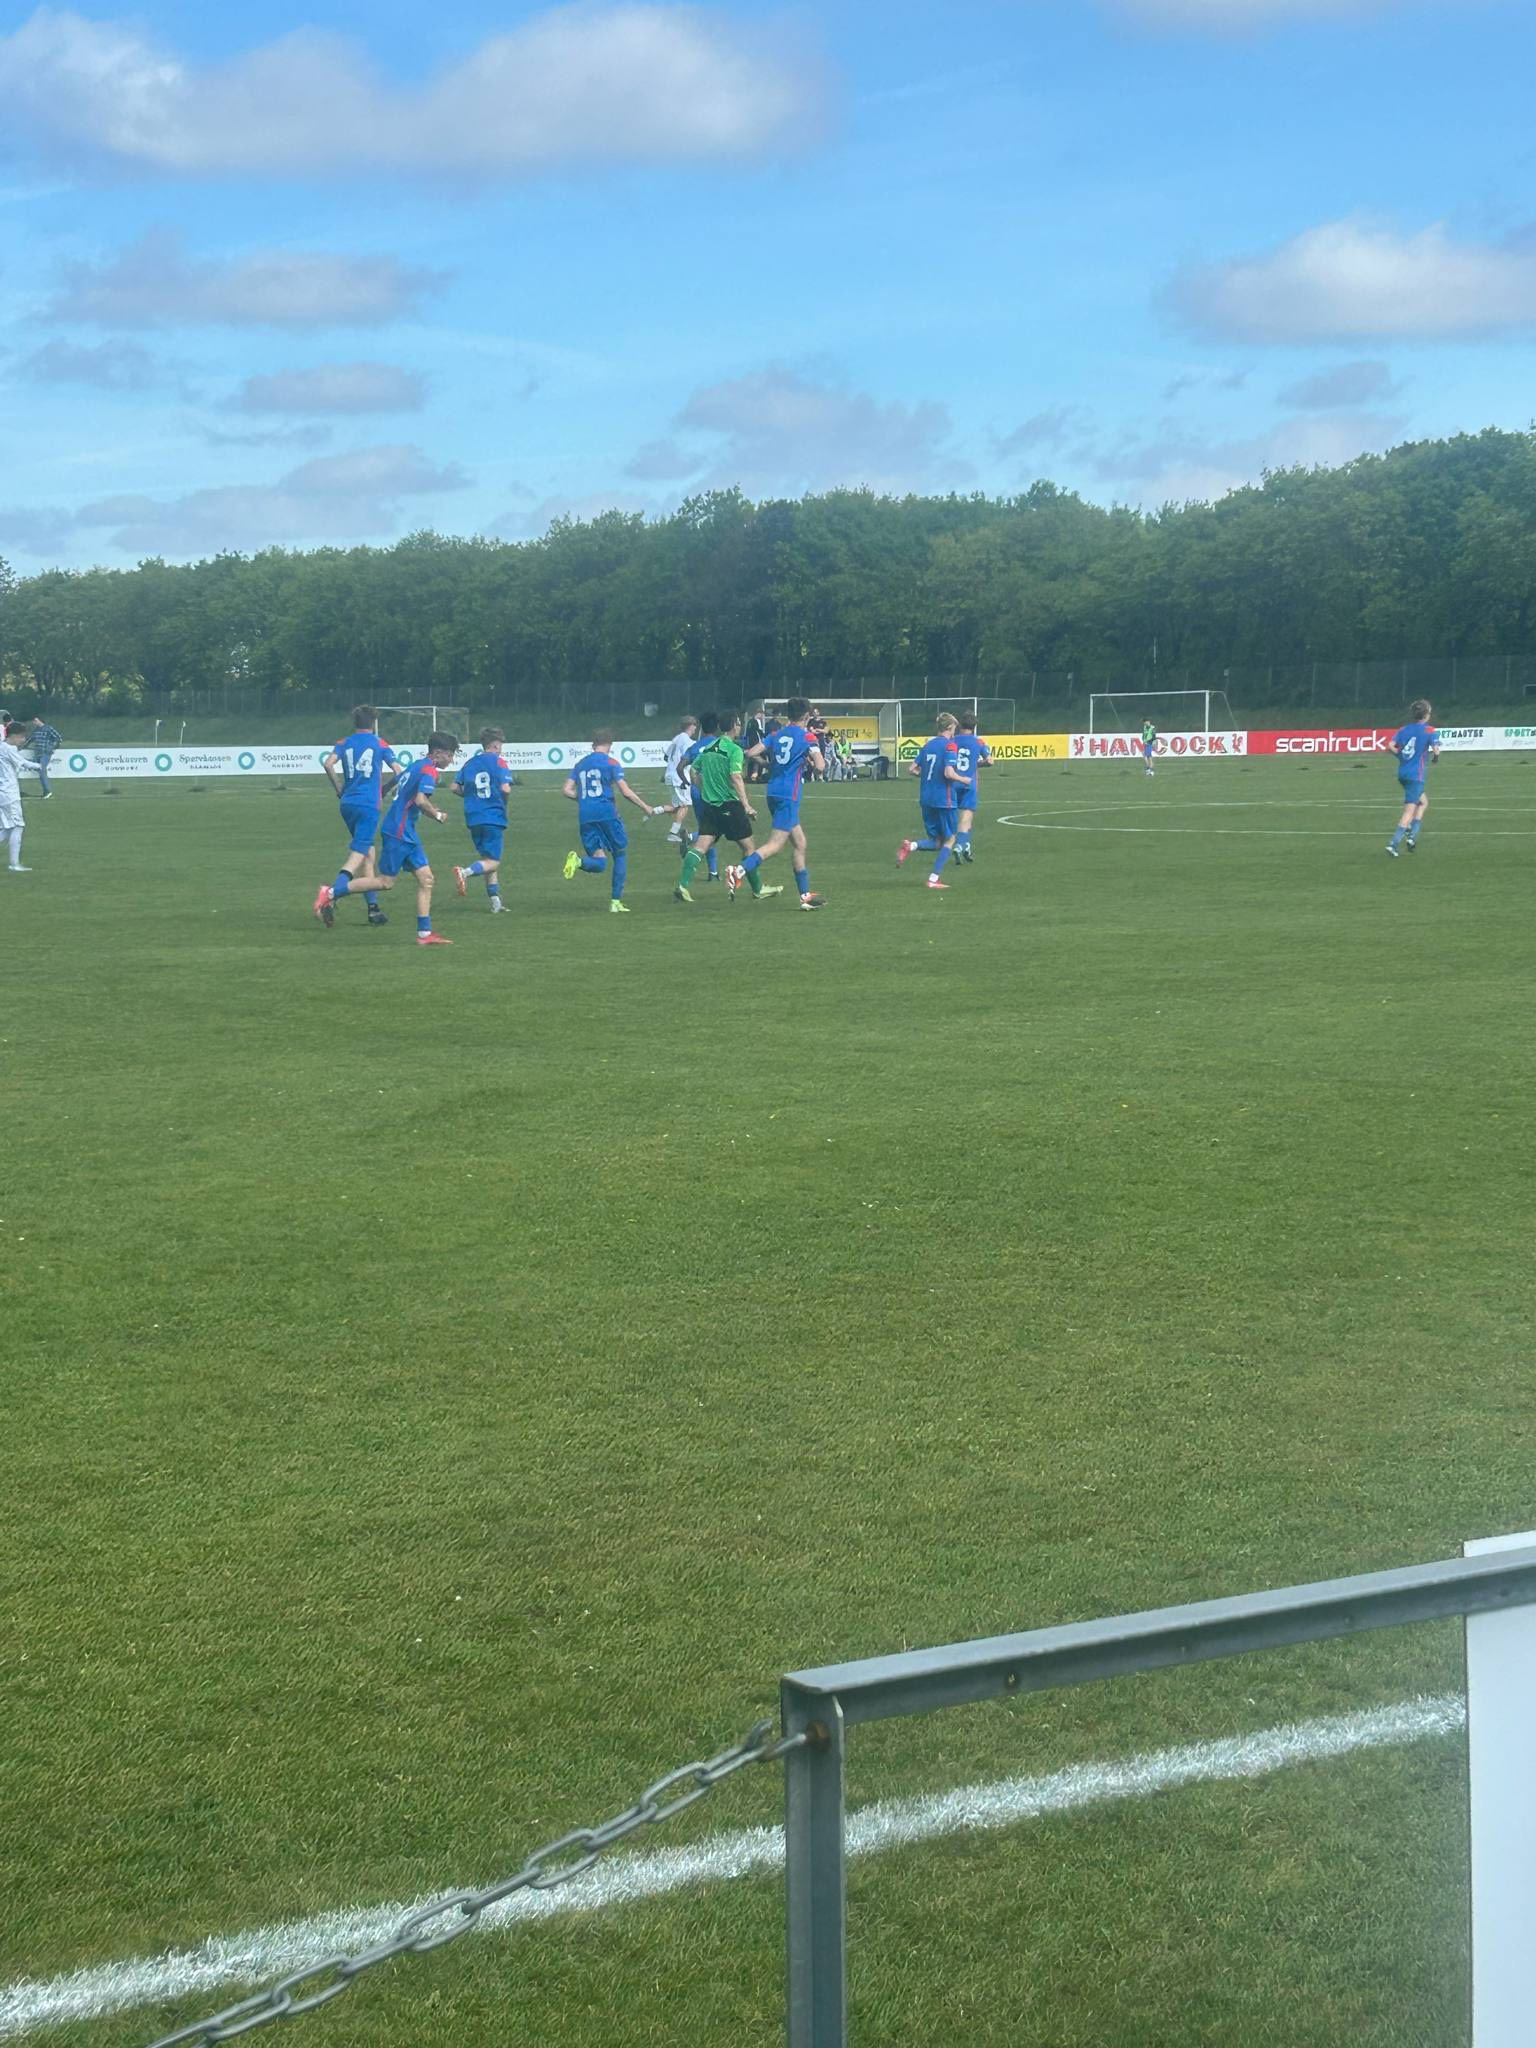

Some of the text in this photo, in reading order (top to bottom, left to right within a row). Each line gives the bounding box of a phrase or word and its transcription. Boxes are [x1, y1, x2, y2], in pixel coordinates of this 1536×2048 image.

[775, 736, 793, 764] 3
[1089, 736, 1227, 756] HANCOCK
[1276, 730, 1386, 753] scantruck
[1401, 736, 1416, 760] 4
[345, 748, 374, 779] 14
[926, 754, 937, 781] 7
[475, 771, 491, 798] 9
[579, 769, 603, 799] 13
